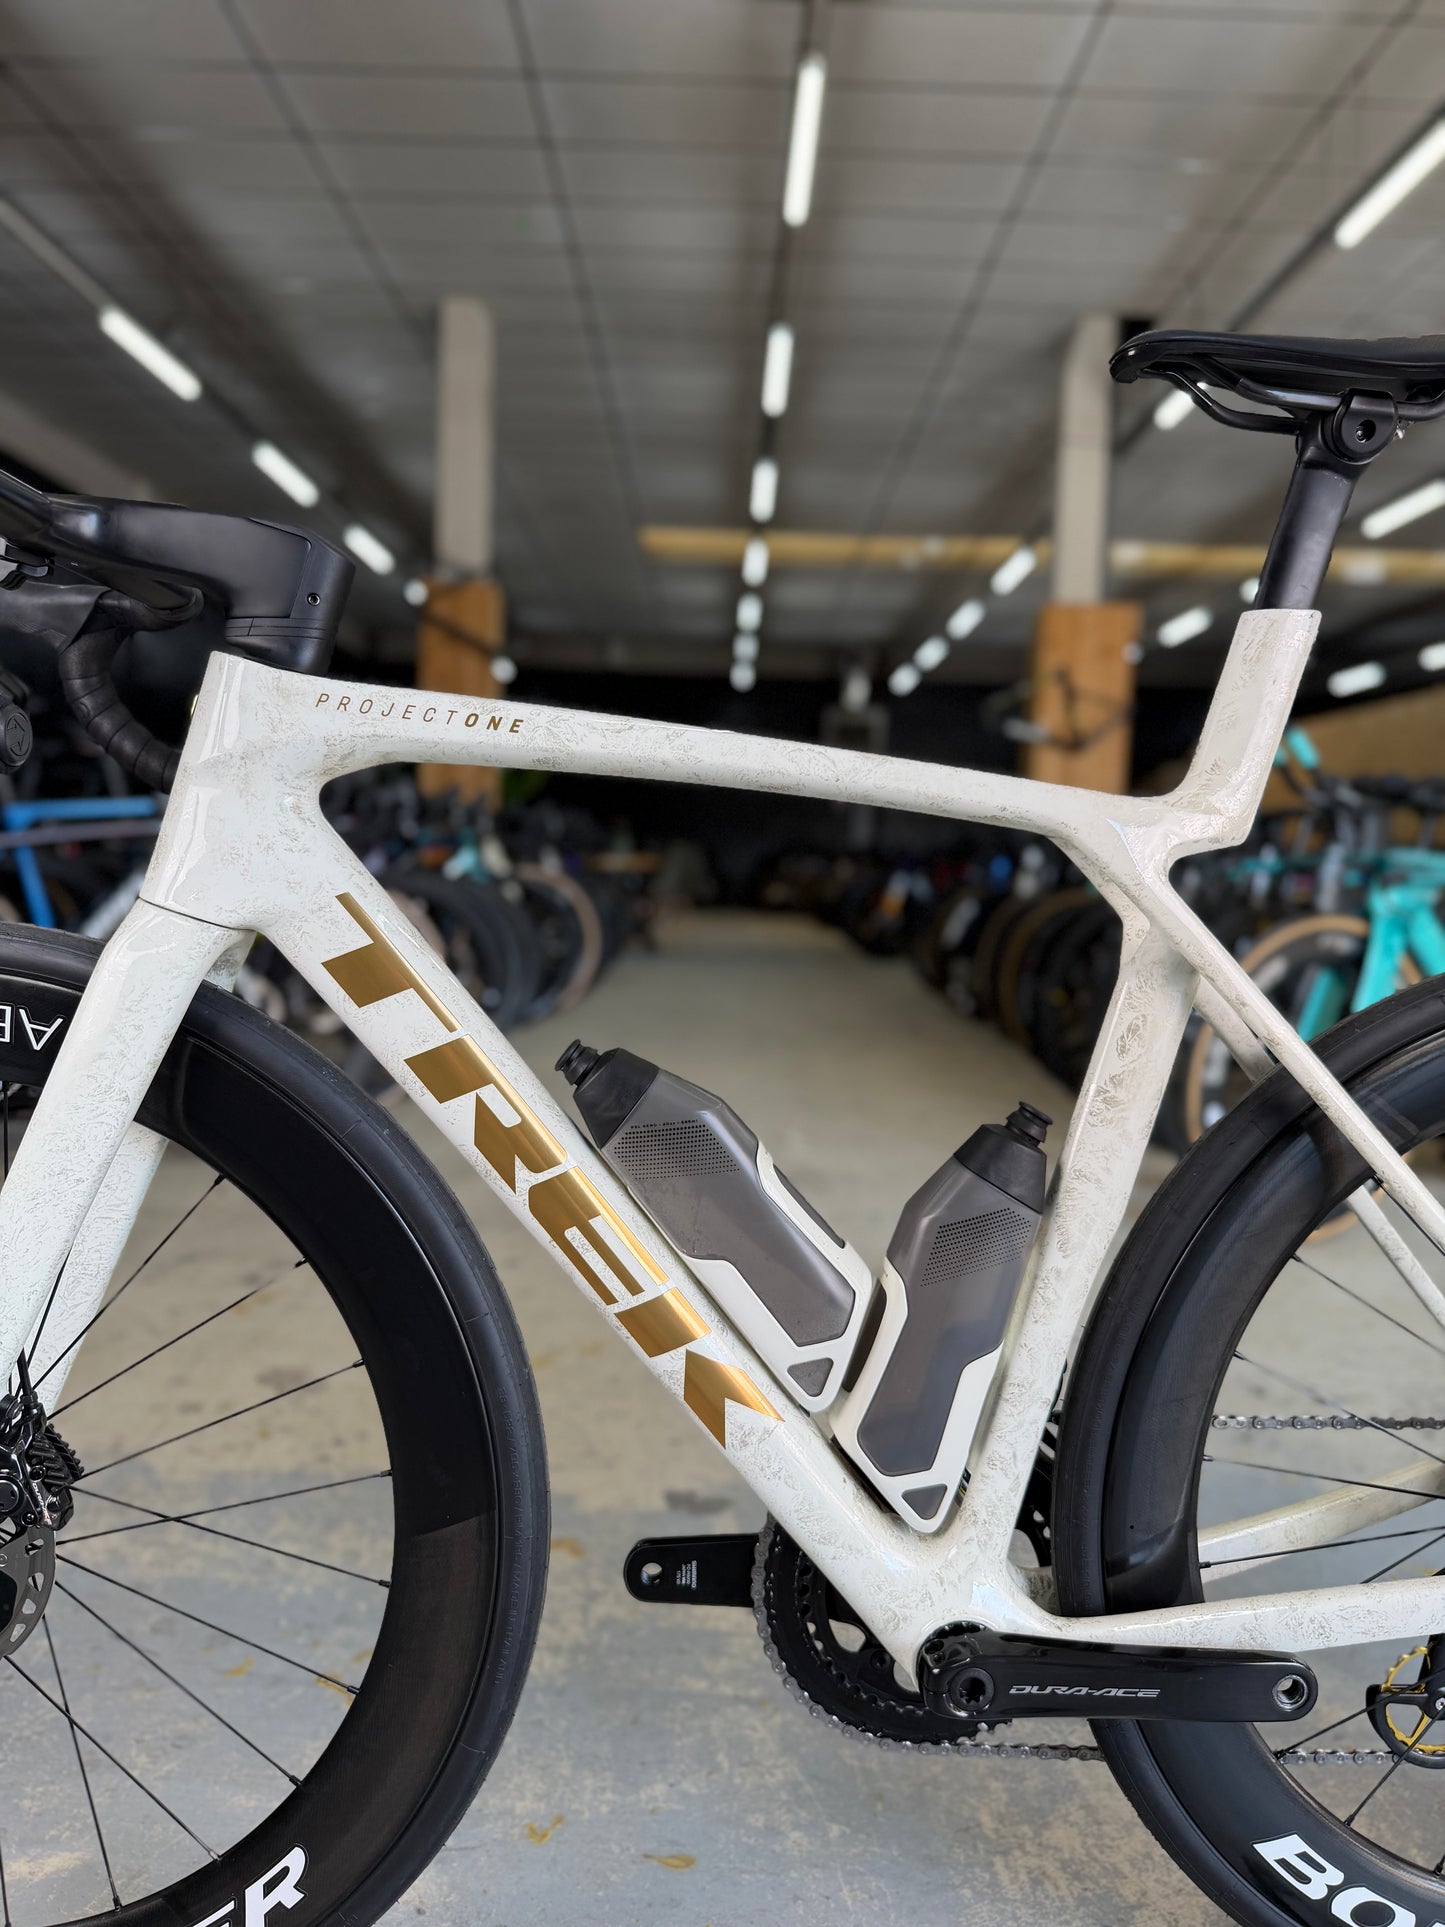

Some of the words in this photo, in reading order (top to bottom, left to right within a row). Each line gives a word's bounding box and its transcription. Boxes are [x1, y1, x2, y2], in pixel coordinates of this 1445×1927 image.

[321, 892, 784, 1450] TREK
[1008, 1685, 1161, 1698] DURA-ACE
[1252, 1833, 1445, 1927] BO
